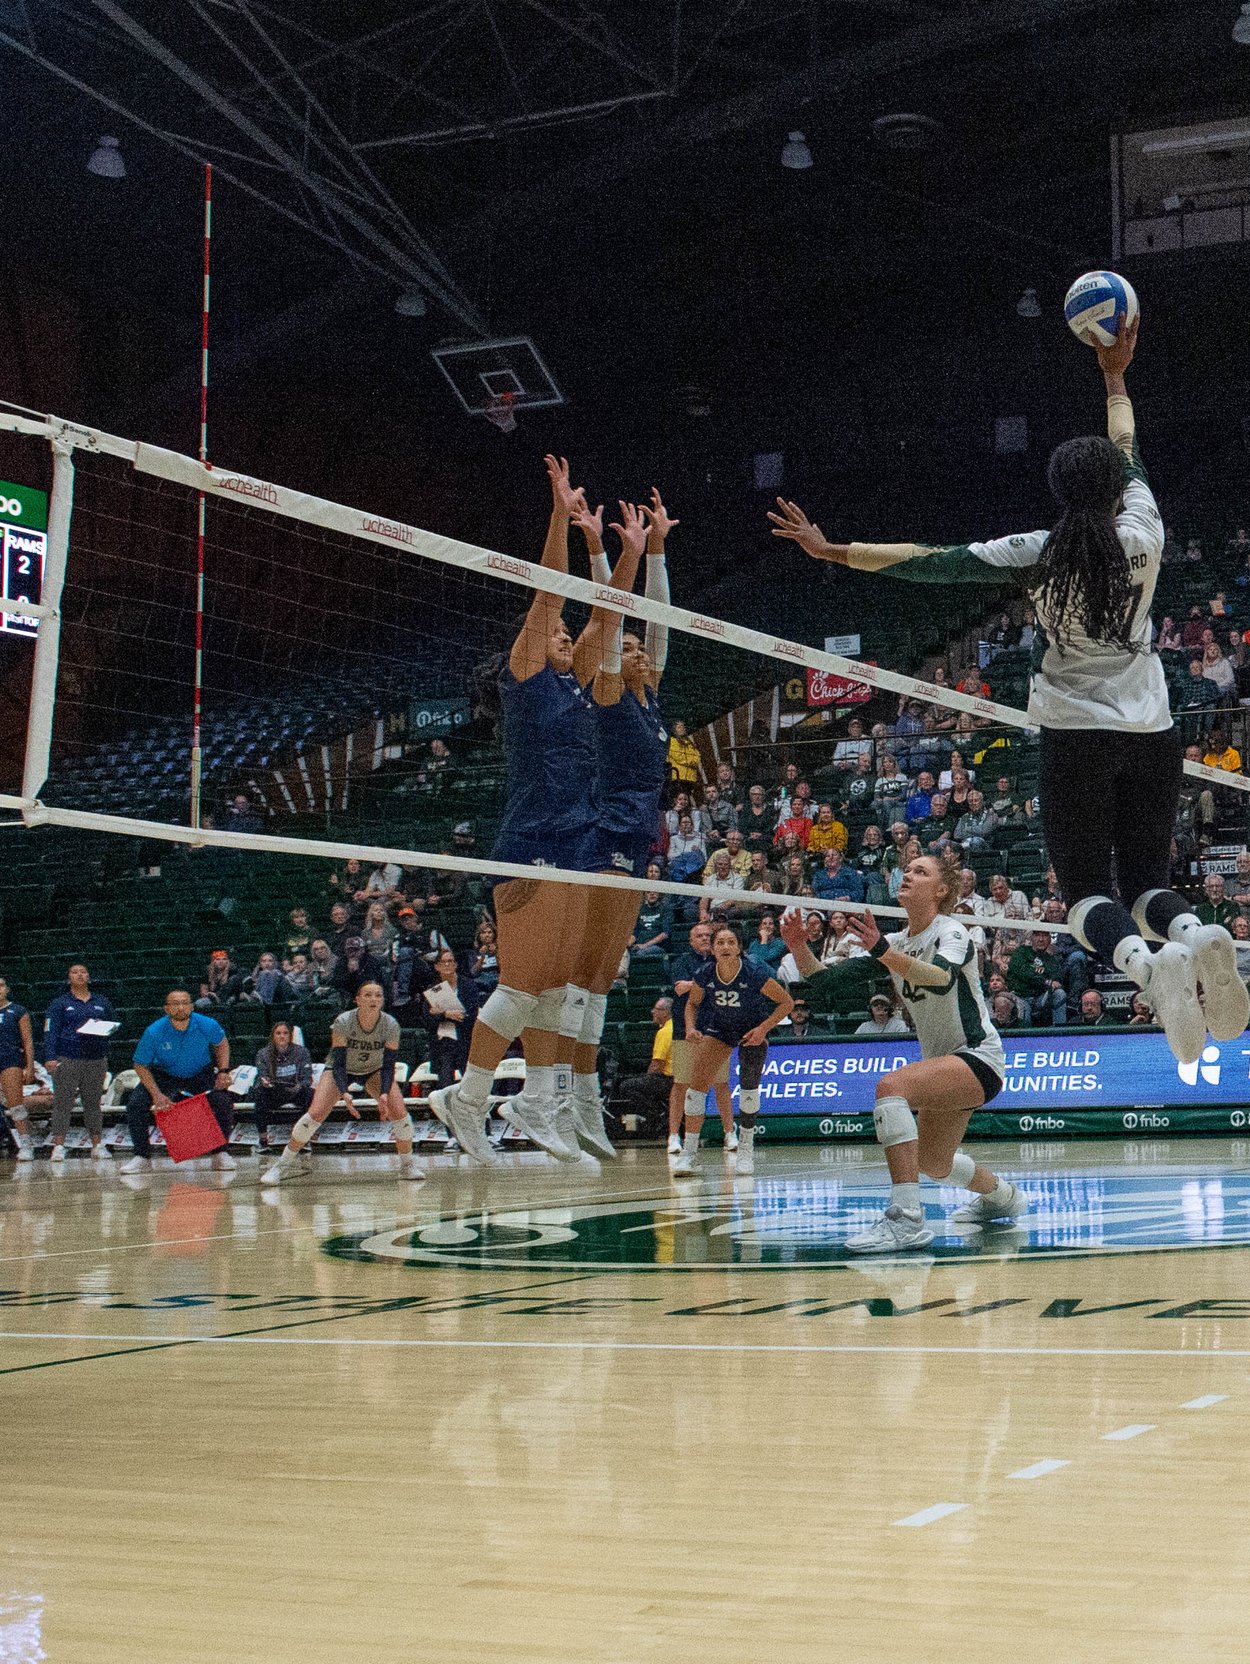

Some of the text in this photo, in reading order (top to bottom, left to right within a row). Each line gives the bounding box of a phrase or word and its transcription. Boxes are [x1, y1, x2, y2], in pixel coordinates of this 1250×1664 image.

[219, 475, 278, 504] uchealth
[362, 516, 413, 545] uchealth
[7, 533, 44, 554] RAMS
[18, 555, 30, 574] 2
[487, 553, 532, 578] uchealth
[594, 587, 636, 609] uchealth
[690, 616, 725, 635] uchealth
[773, 641, 805, 660] uchealth
[785, 678, 804, 700] G
[1210, 864, 1236, 873] RAMS
[714, 990, 741, 1008] 32
[1103, 996, 1132, 1006] RAMS
[358, 1052, 370, 1062] 3
[735, 1056, 908, 1076] ACHES BUILD
[1032, 1050, 1100, 1067] BUILD
[731, 1081, 843, 1099] AHLETES.
[834, 1119, 863, 1134] fnbo
[1034, 1116, 1065, 1130] fnbo
[1139, 1112, 1170, 1128] fnbo
